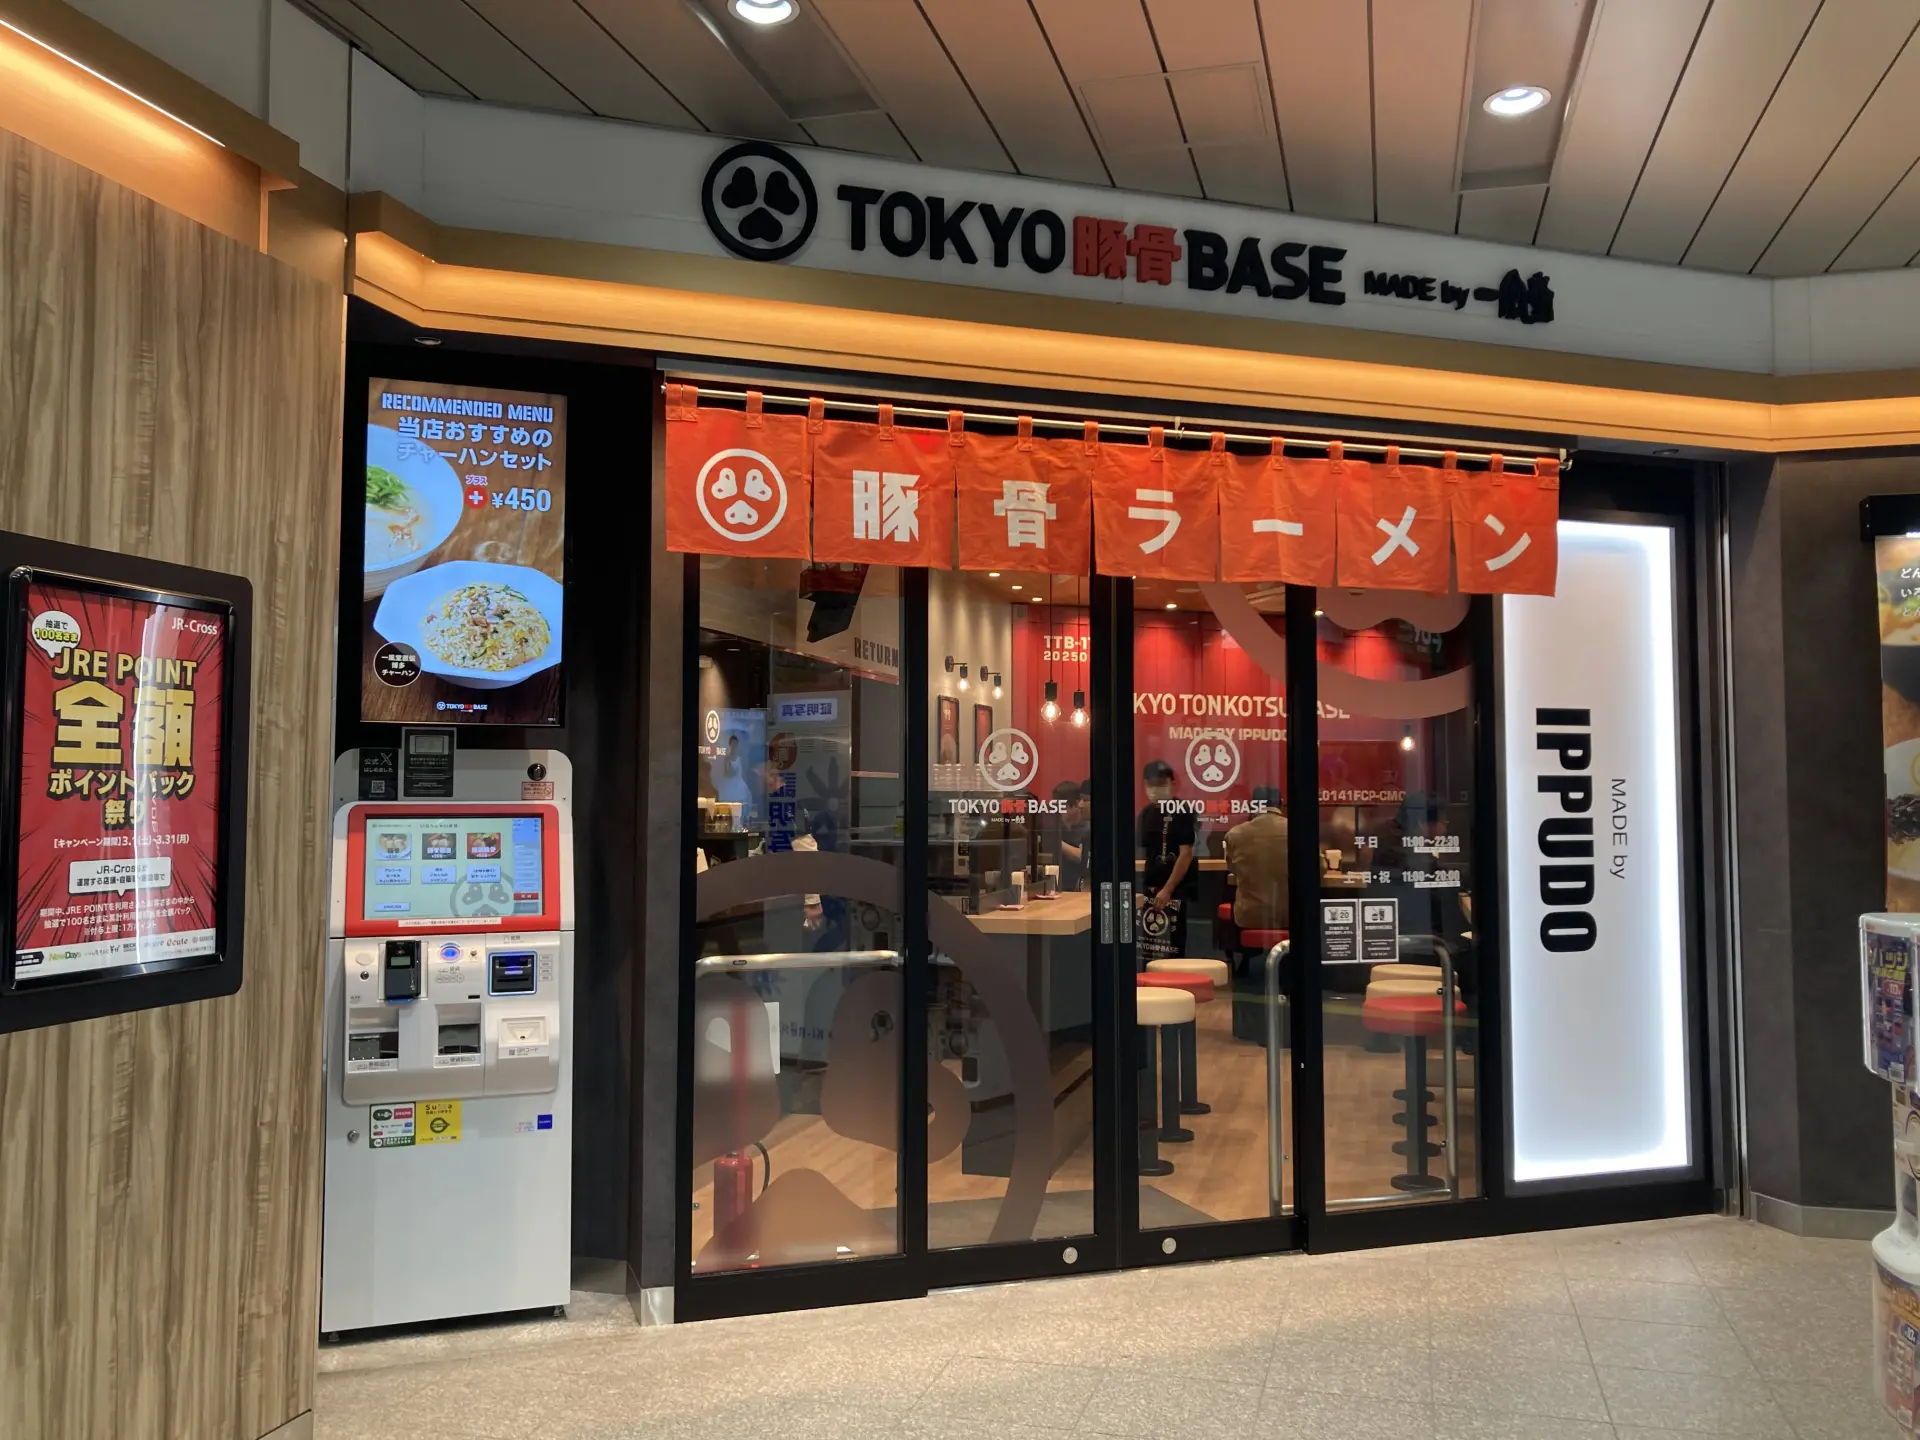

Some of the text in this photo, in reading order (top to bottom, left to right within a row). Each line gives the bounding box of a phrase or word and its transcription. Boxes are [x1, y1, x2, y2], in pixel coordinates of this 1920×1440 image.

[1364, 271, 1437, 302] MADE
[1441, 279, 1470, 310] by
[382, 392, 553, 423] RECOMMENDED MENU
[398, 418, 552, 448] 当店おすすめの
[398, 442, 552, 471] チャーハンセット
[466, 475, 488, 486] プラス
[492, 488, 552, 512] ¥450
[852, 469, 1532, 573] 豚骨ラーメン
[34, 629, 78, 643] 100名さま
[172, 617, 218, 635] JR-Cross
[854, 637, 899, 668] RETURN
[1043, 635, 1091, 650] TTB-1
[1043, 650, 1088, 662] 20250
[54, 648, 197, 686] JRE POINT
[381, 669, 415, 677] チャーハン
[53, 680, 194, 767] 全額
[49, 768, 194, 796] ポイントバック
[105, 799, 147, 824] 祭り
[1354, 836, 1378, 849] 平日
[1536, 707, 1597, 953] IPPUDO
[1610, 779, 1628, 879] MADE by
